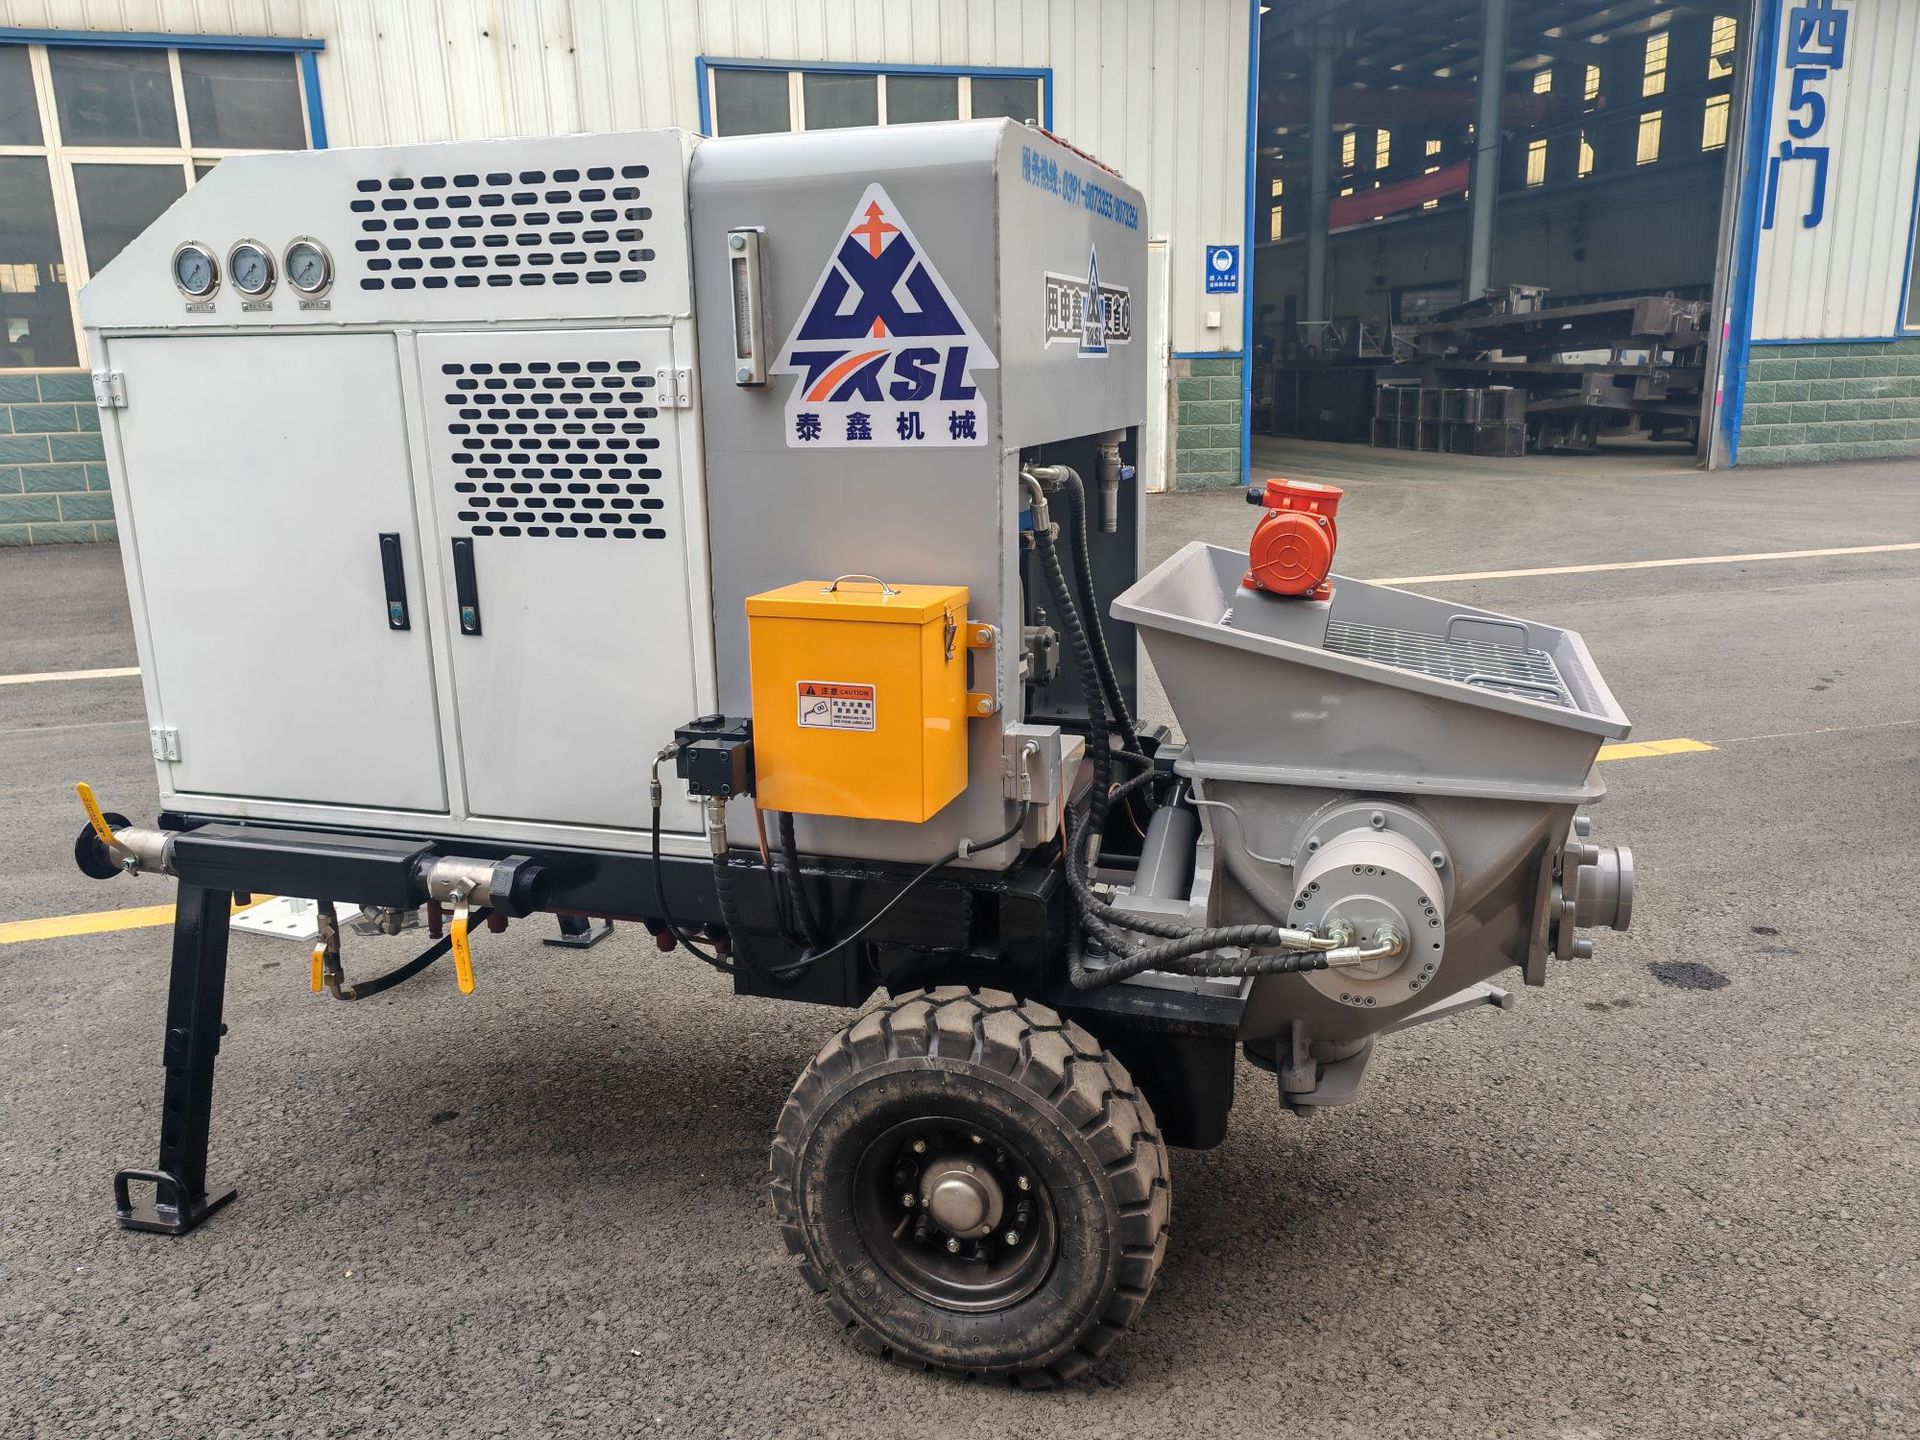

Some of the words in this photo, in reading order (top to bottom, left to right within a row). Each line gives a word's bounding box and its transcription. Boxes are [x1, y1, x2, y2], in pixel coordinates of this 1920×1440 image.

[796, 410, 977, 442] 泰鑫机械
[821, 686, 838, 696] 注意
[840, 688, 869, 697] CAUTION
